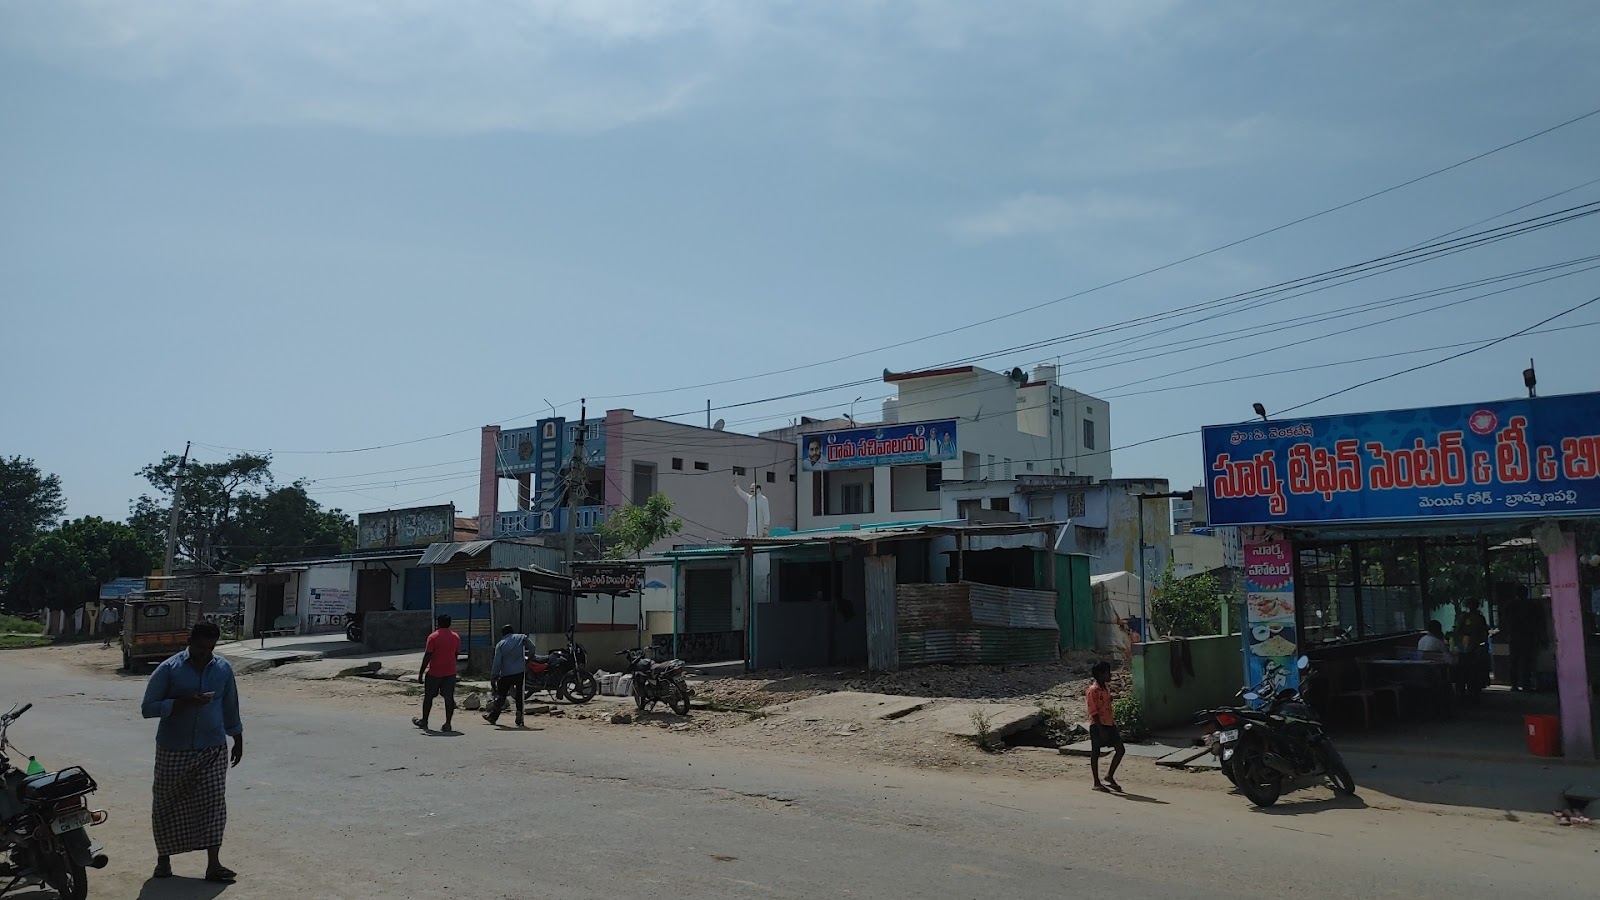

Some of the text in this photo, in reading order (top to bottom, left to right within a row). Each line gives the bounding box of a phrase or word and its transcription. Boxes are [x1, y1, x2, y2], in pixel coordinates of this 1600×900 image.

[827, 433, 926, 463] గ్రామ సచివాలయం
[1213, 449, 1287, 515] సూర్య
[1287, 440, 1362, 502] టిఫిన్
[1367, 432, 1466, 489] సెంటర్
[1495, 416, 1530, 483] టీ
[1418, 493, 1465, 509] మెయిన్
[1466, 493, 1493, 506] రోడ్
[1252, 544, 1285, 560] సూర్య
[1248, 563, 1291, 577] హోటల్
